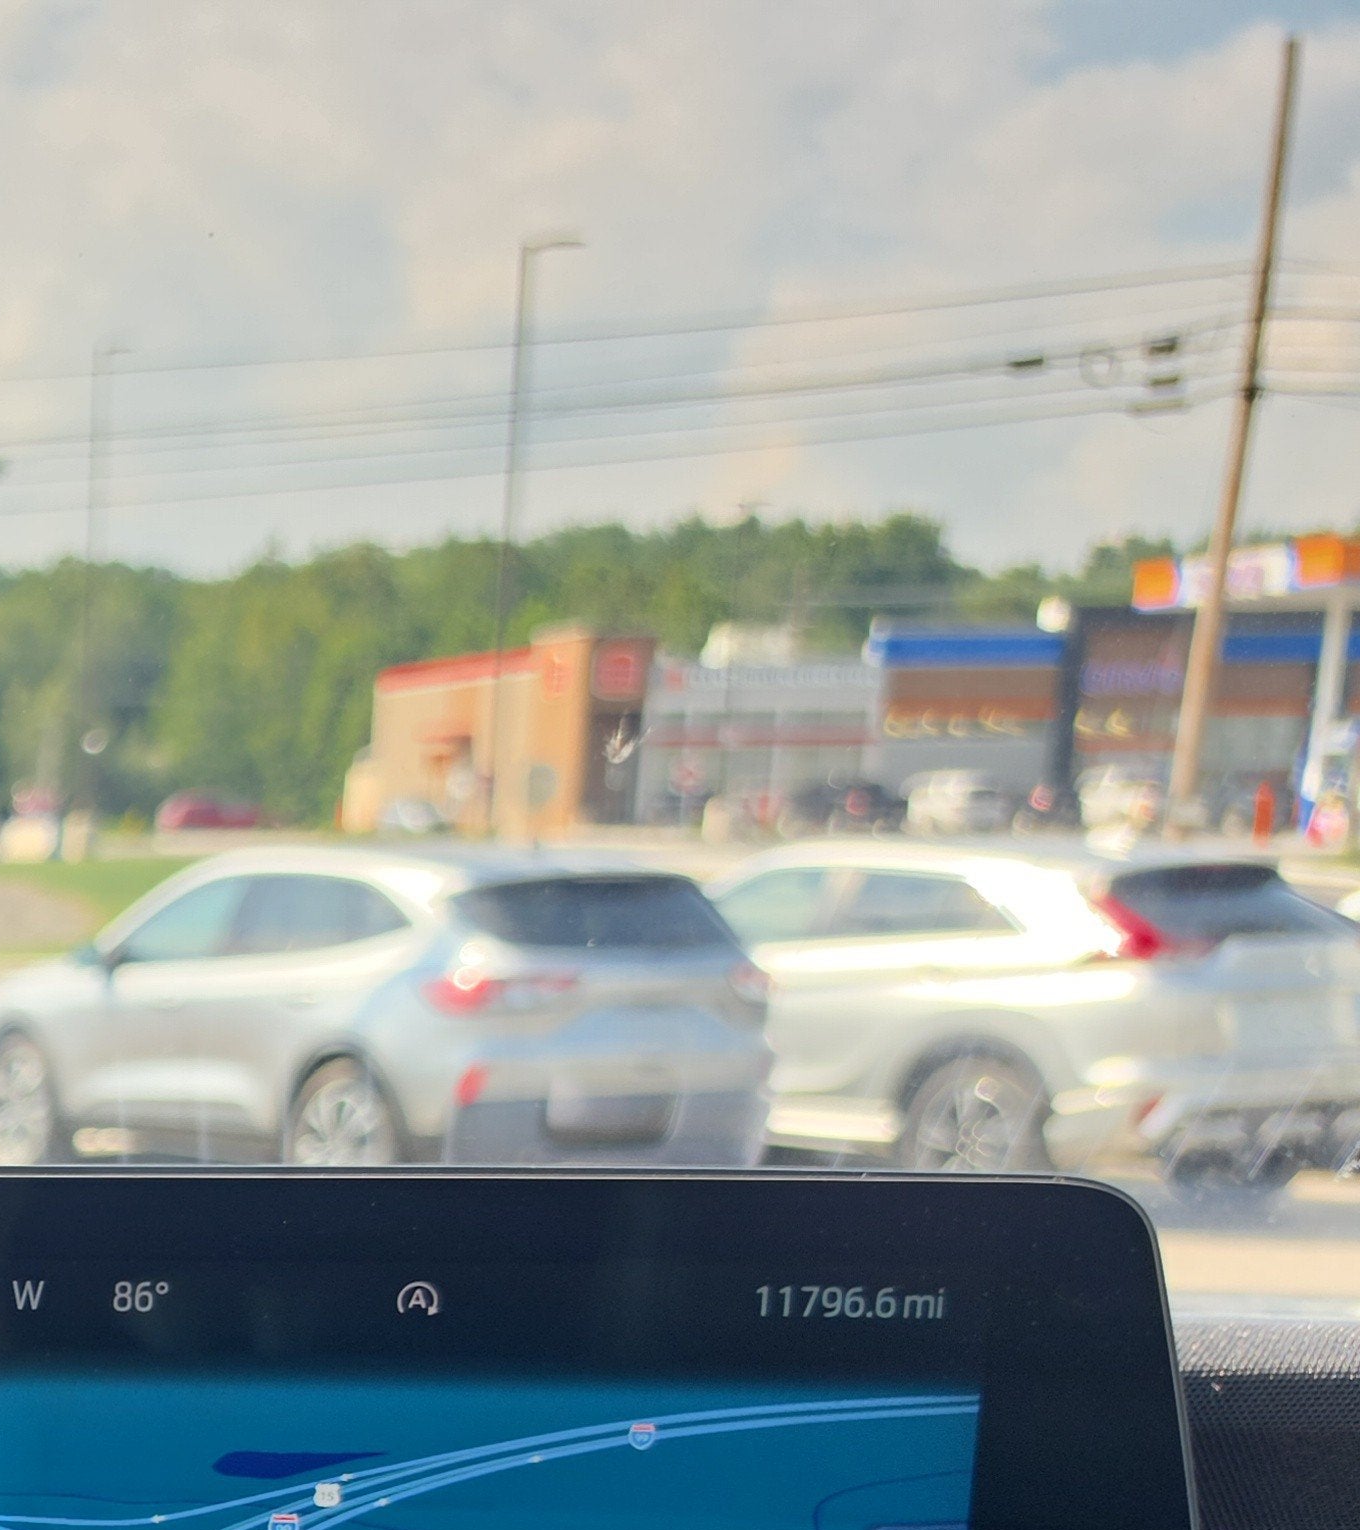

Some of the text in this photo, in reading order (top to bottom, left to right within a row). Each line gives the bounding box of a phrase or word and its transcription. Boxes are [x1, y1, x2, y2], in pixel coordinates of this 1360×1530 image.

[12, 1280, 44, 1310] W
[112, 1281, 170, 1312] 86°
[755, 1285, 946, 1319] 11796.6 mi
